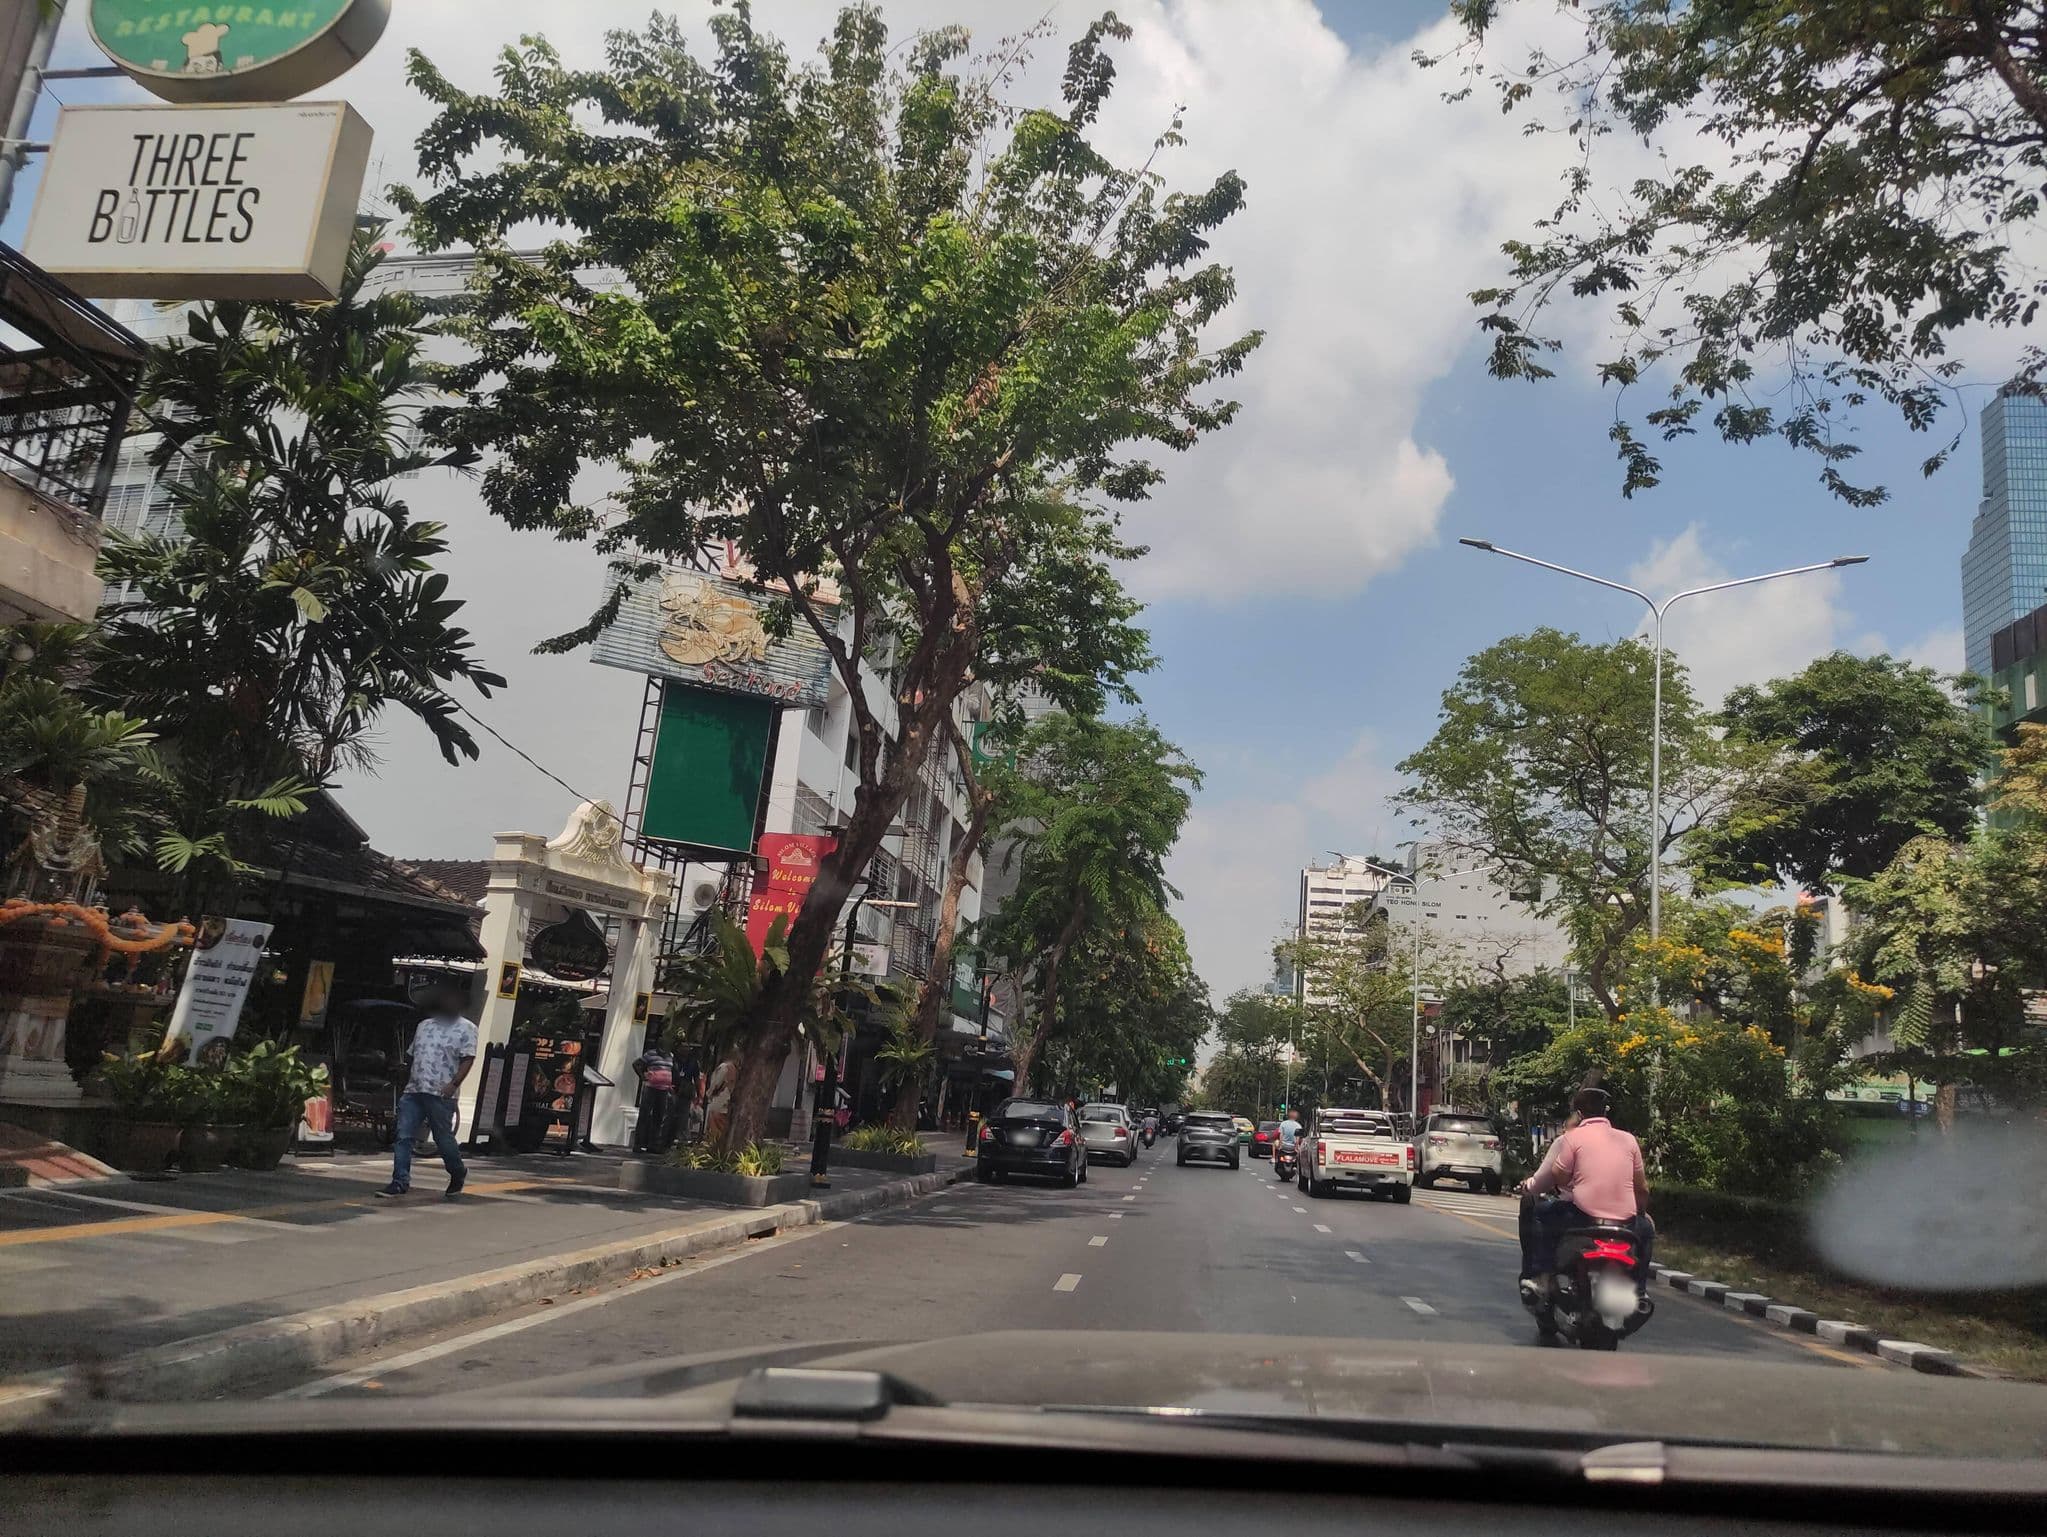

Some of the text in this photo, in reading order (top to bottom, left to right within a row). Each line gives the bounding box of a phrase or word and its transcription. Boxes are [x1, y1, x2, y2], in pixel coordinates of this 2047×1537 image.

[115, 5, 316, 37] RESTAURANT
[128, 132, 256, 186] THREE
[753, 899, 783, 912] Silom
[1341, 1154, 1379, 1165] LALAMOVE
